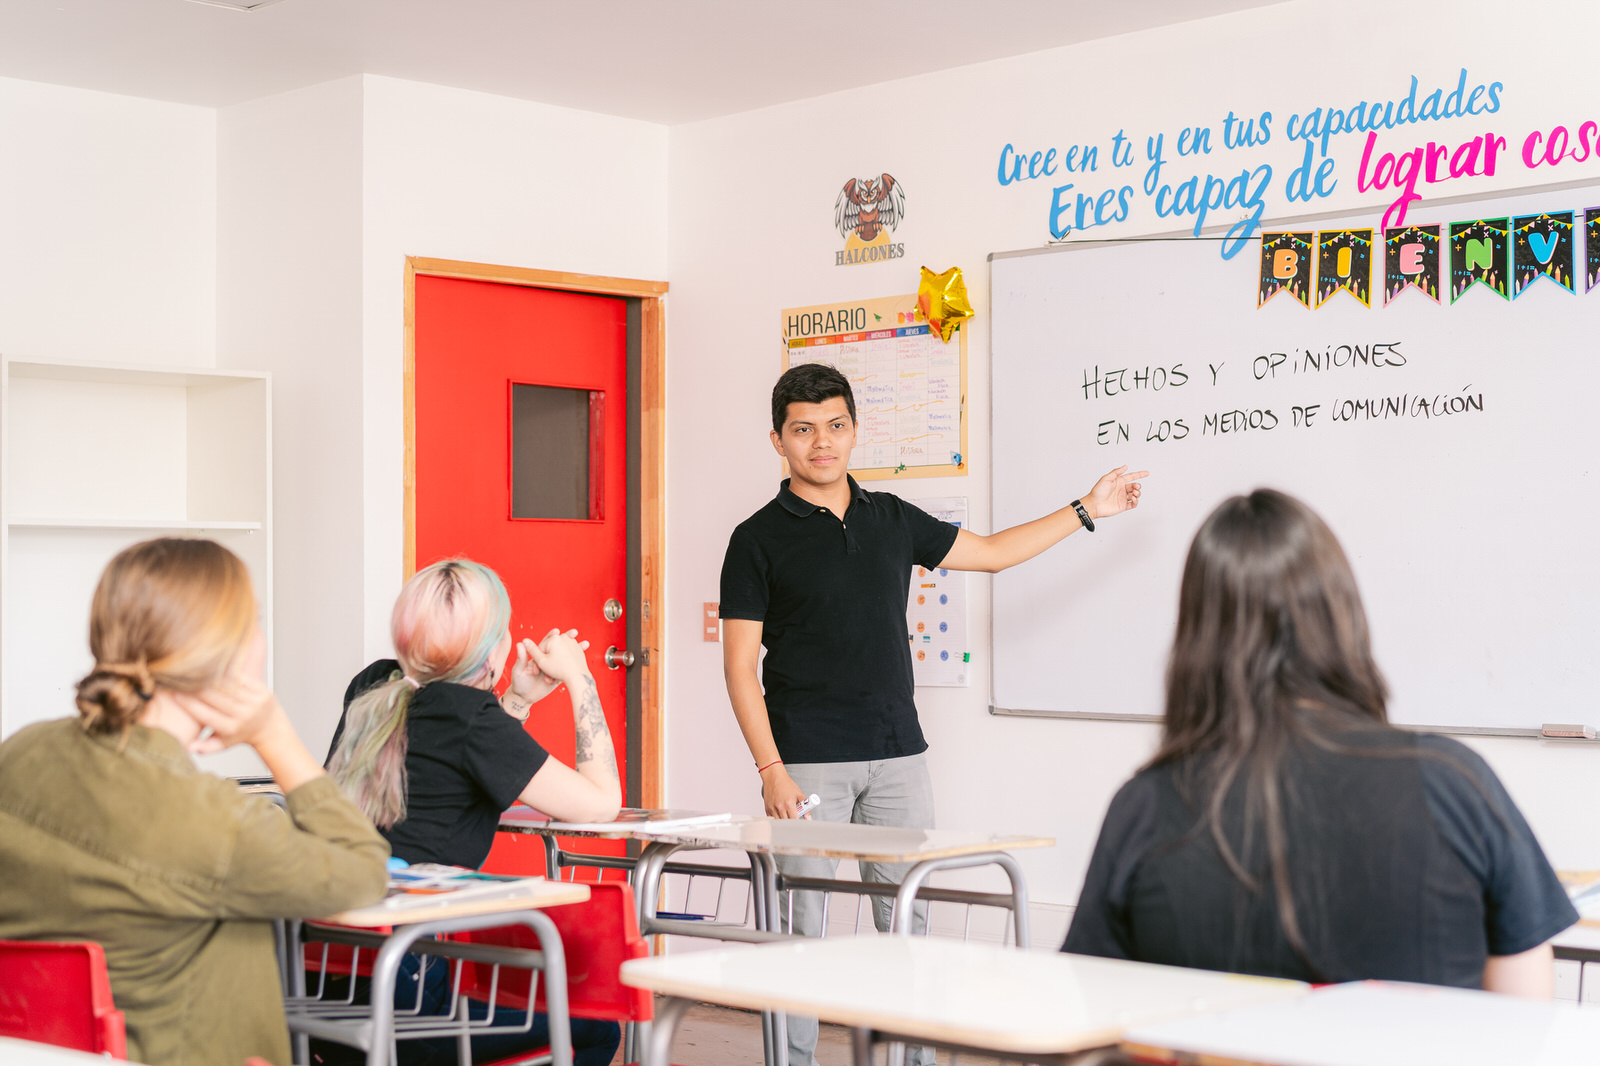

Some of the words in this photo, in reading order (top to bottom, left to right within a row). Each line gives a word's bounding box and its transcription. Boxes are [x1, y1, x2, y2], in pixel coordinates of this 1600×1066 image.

[998, 143, 1058, 186] Cree
[1066, 144, 1098, 172] en
[1144, 133, 1167, 196] y
[1177, 127, 1213, 156] en
[1223, 111, 1272, 150] tus
[1286, 68, 1503, 157] capacidades
[1049, 183, 1134, 240] Eres
[1155, 164, 1272, 260] capaz
[1285, 139, 1338, 202] de
[1357, 131, 1507, 238] lograr
[835, 243, 905, 266] HALCONES
[789, 307, 866, 337] HORARIO
[1081, 363, 1189, 400] HECHOS
[1209, 361, 1225, 386] Y
[1097, 420, 1130, 445] EN
[1146, 419, 1190, 442] LOS
[1291, 404, 1320, 428] DE
